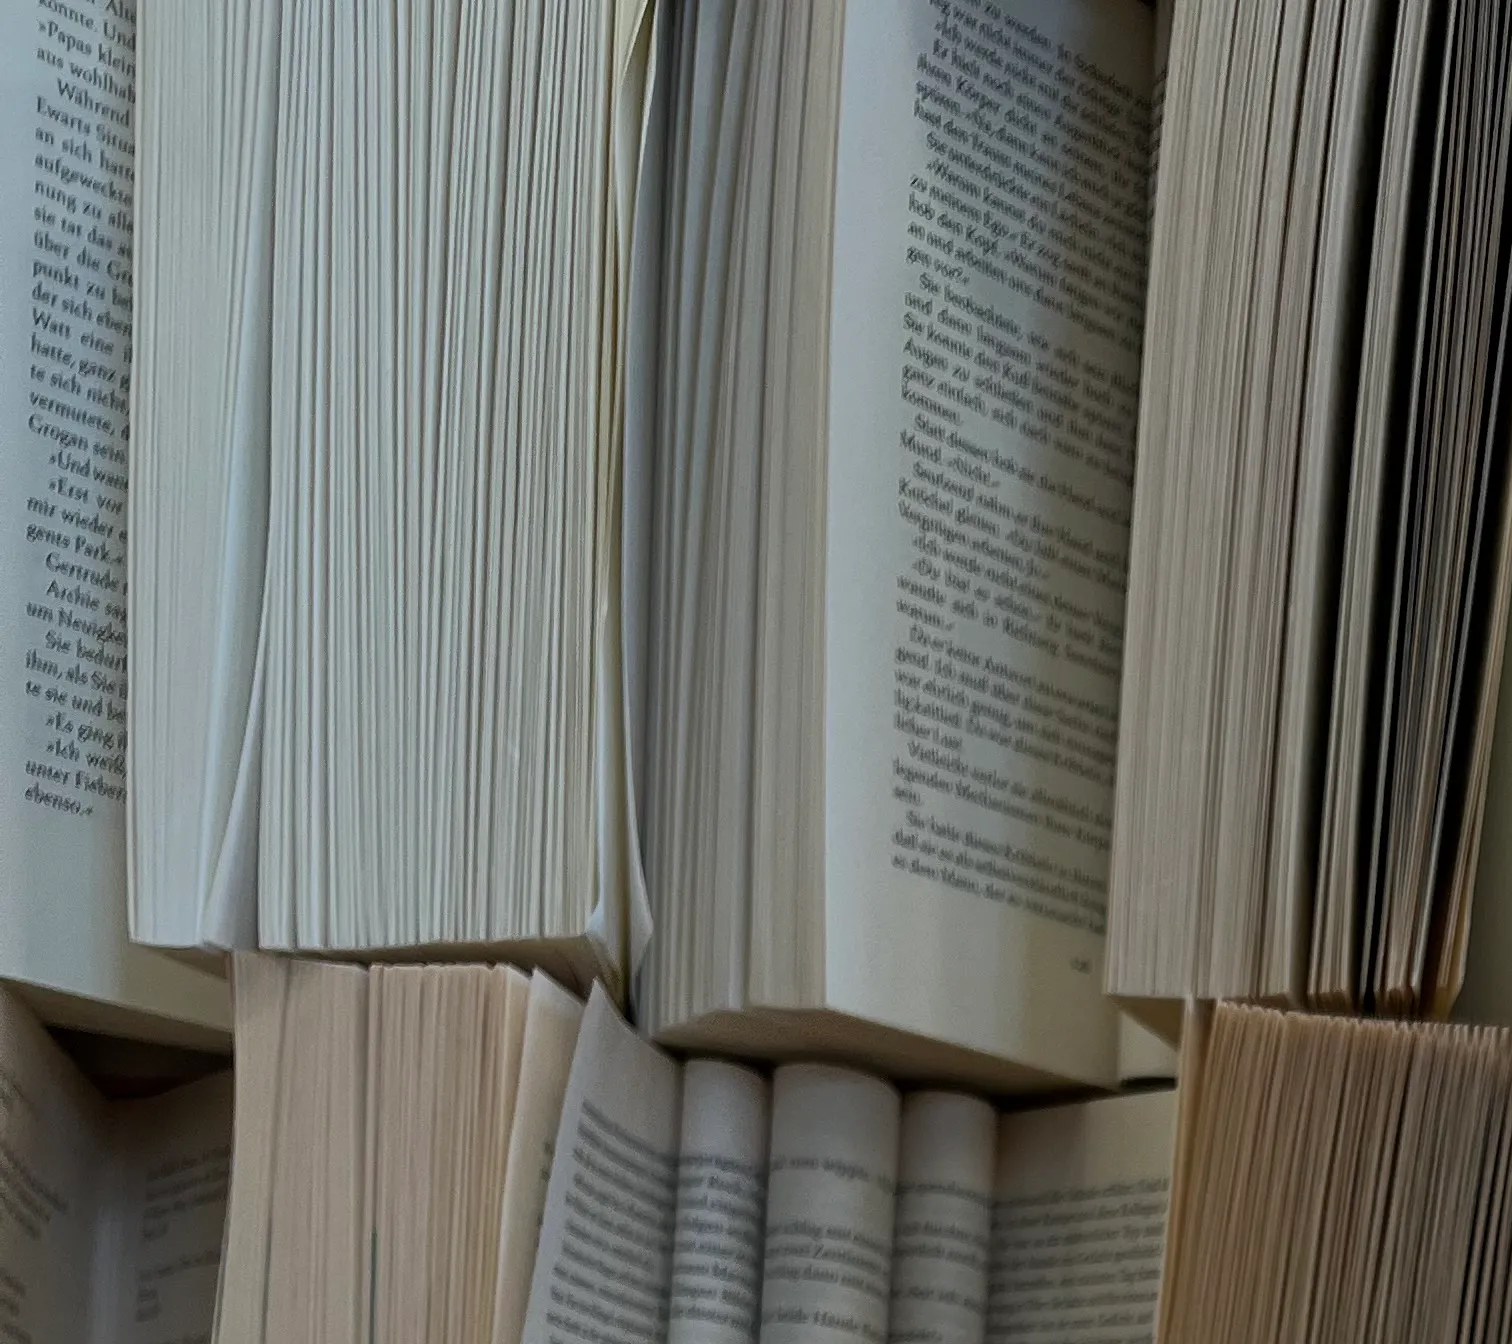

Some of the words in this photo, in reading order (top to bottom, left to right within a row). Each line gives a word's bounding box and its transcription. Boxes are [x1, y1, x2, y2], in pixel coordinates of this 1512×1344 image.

[37, 48, 63, 68] aus
[57, 77, 129, 128] Während
[35, 127, 53, 145] an
[61, 138, 92, 162] sich
[34, 204, 55, 225] sie
[82, 202, 101, 219] zu
[31, 331, 75, 369] hatte,
